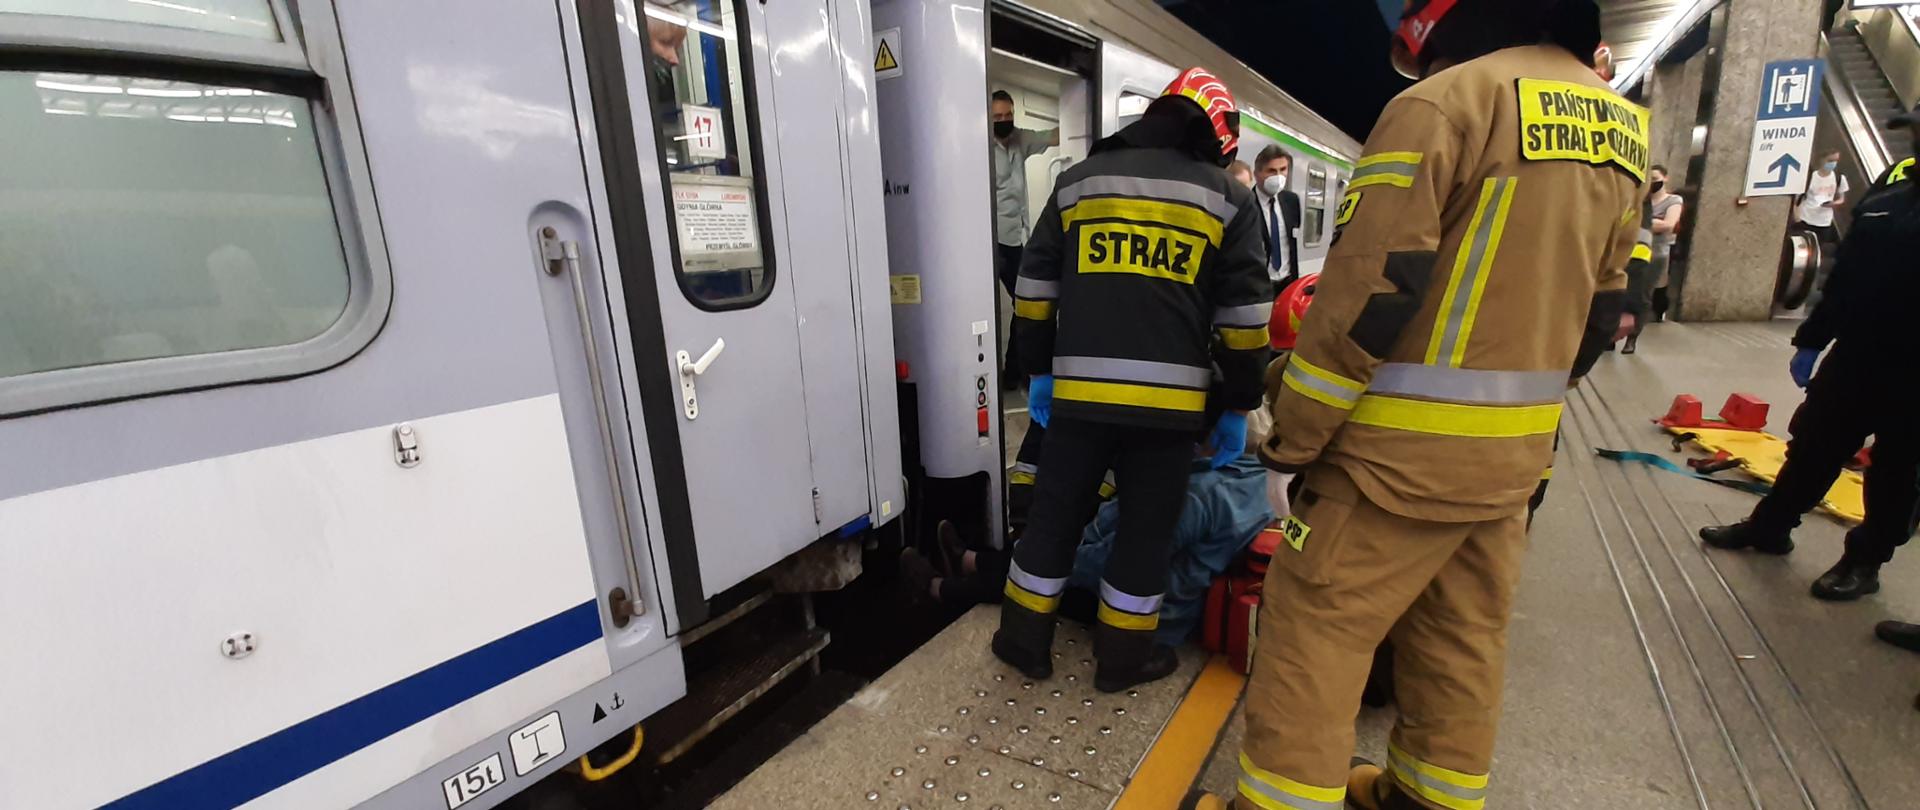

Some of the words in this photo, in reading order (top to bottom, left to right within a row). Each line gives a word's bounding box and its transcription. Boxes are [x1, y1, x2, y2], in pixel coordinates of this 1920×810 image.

[694, 115, 711, 148] 17
[1762, 126, 1806, 140] WINDA
[1759, 142, 1774, 151] lift
[1286, 519, 1303, 542] PSP
[451, 764, 498, 801] 15t
